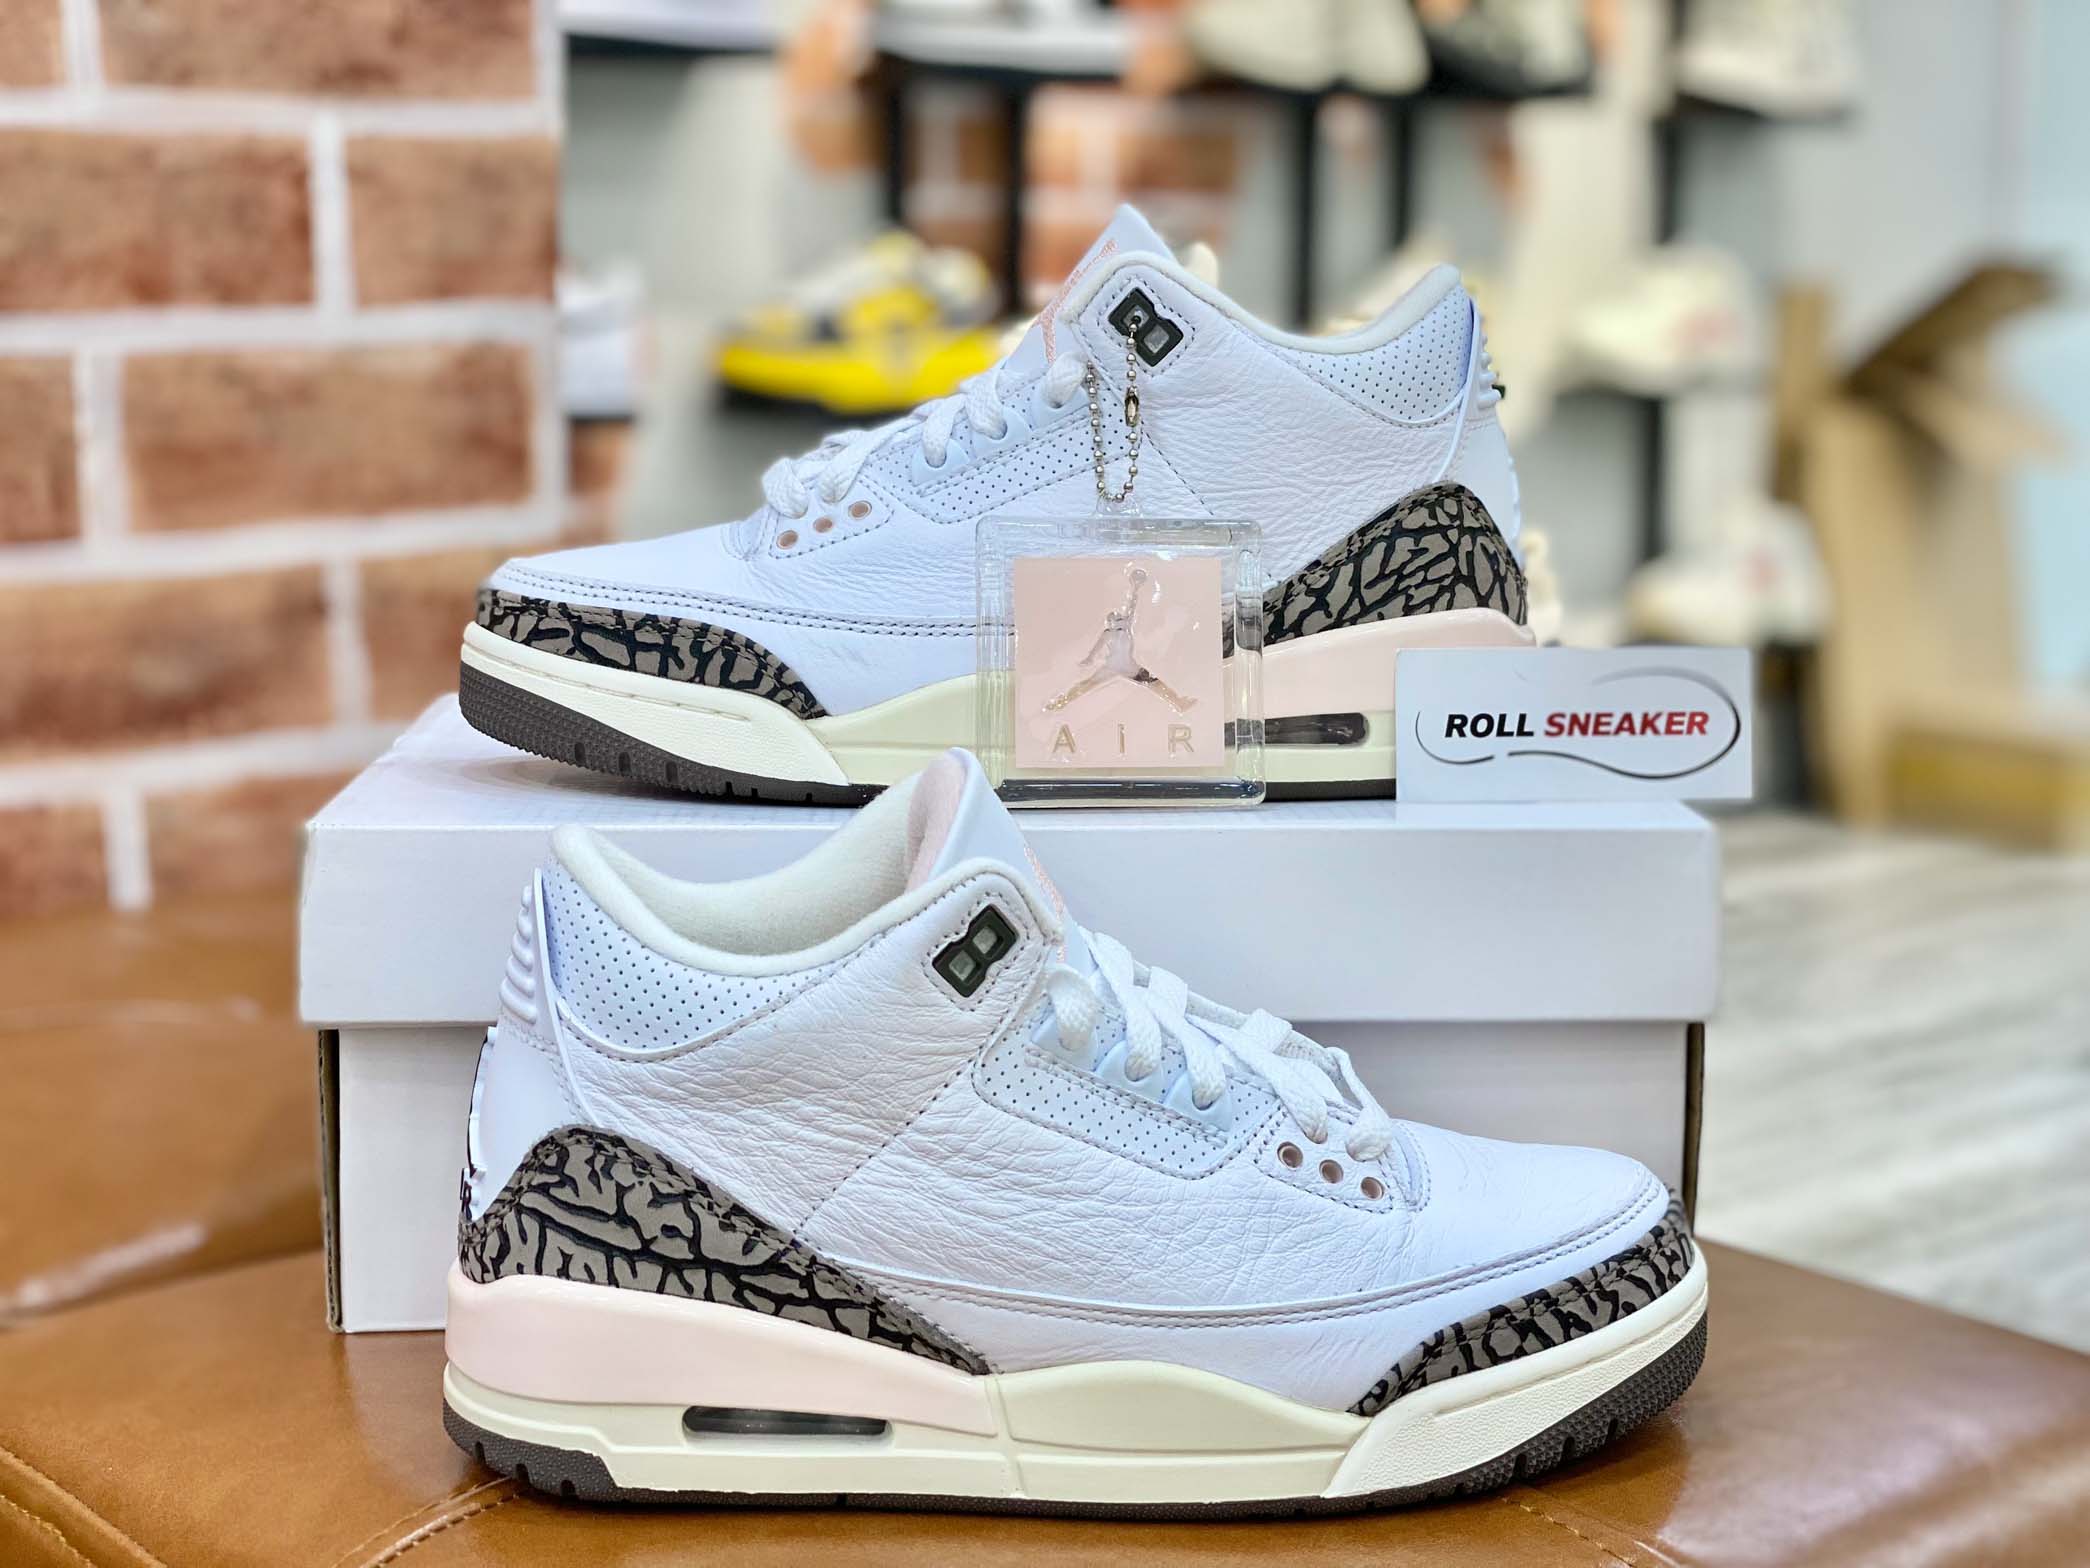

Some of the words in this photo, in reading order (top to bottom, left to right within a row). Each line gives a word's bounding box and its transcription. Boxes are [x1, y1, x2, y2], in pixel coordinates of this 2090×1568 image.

[1052, 723, 1195, 754] AIR
[1444, 713, 1535, 738] ROLL
[1544, 711, 1710, 737] SNEAKER
